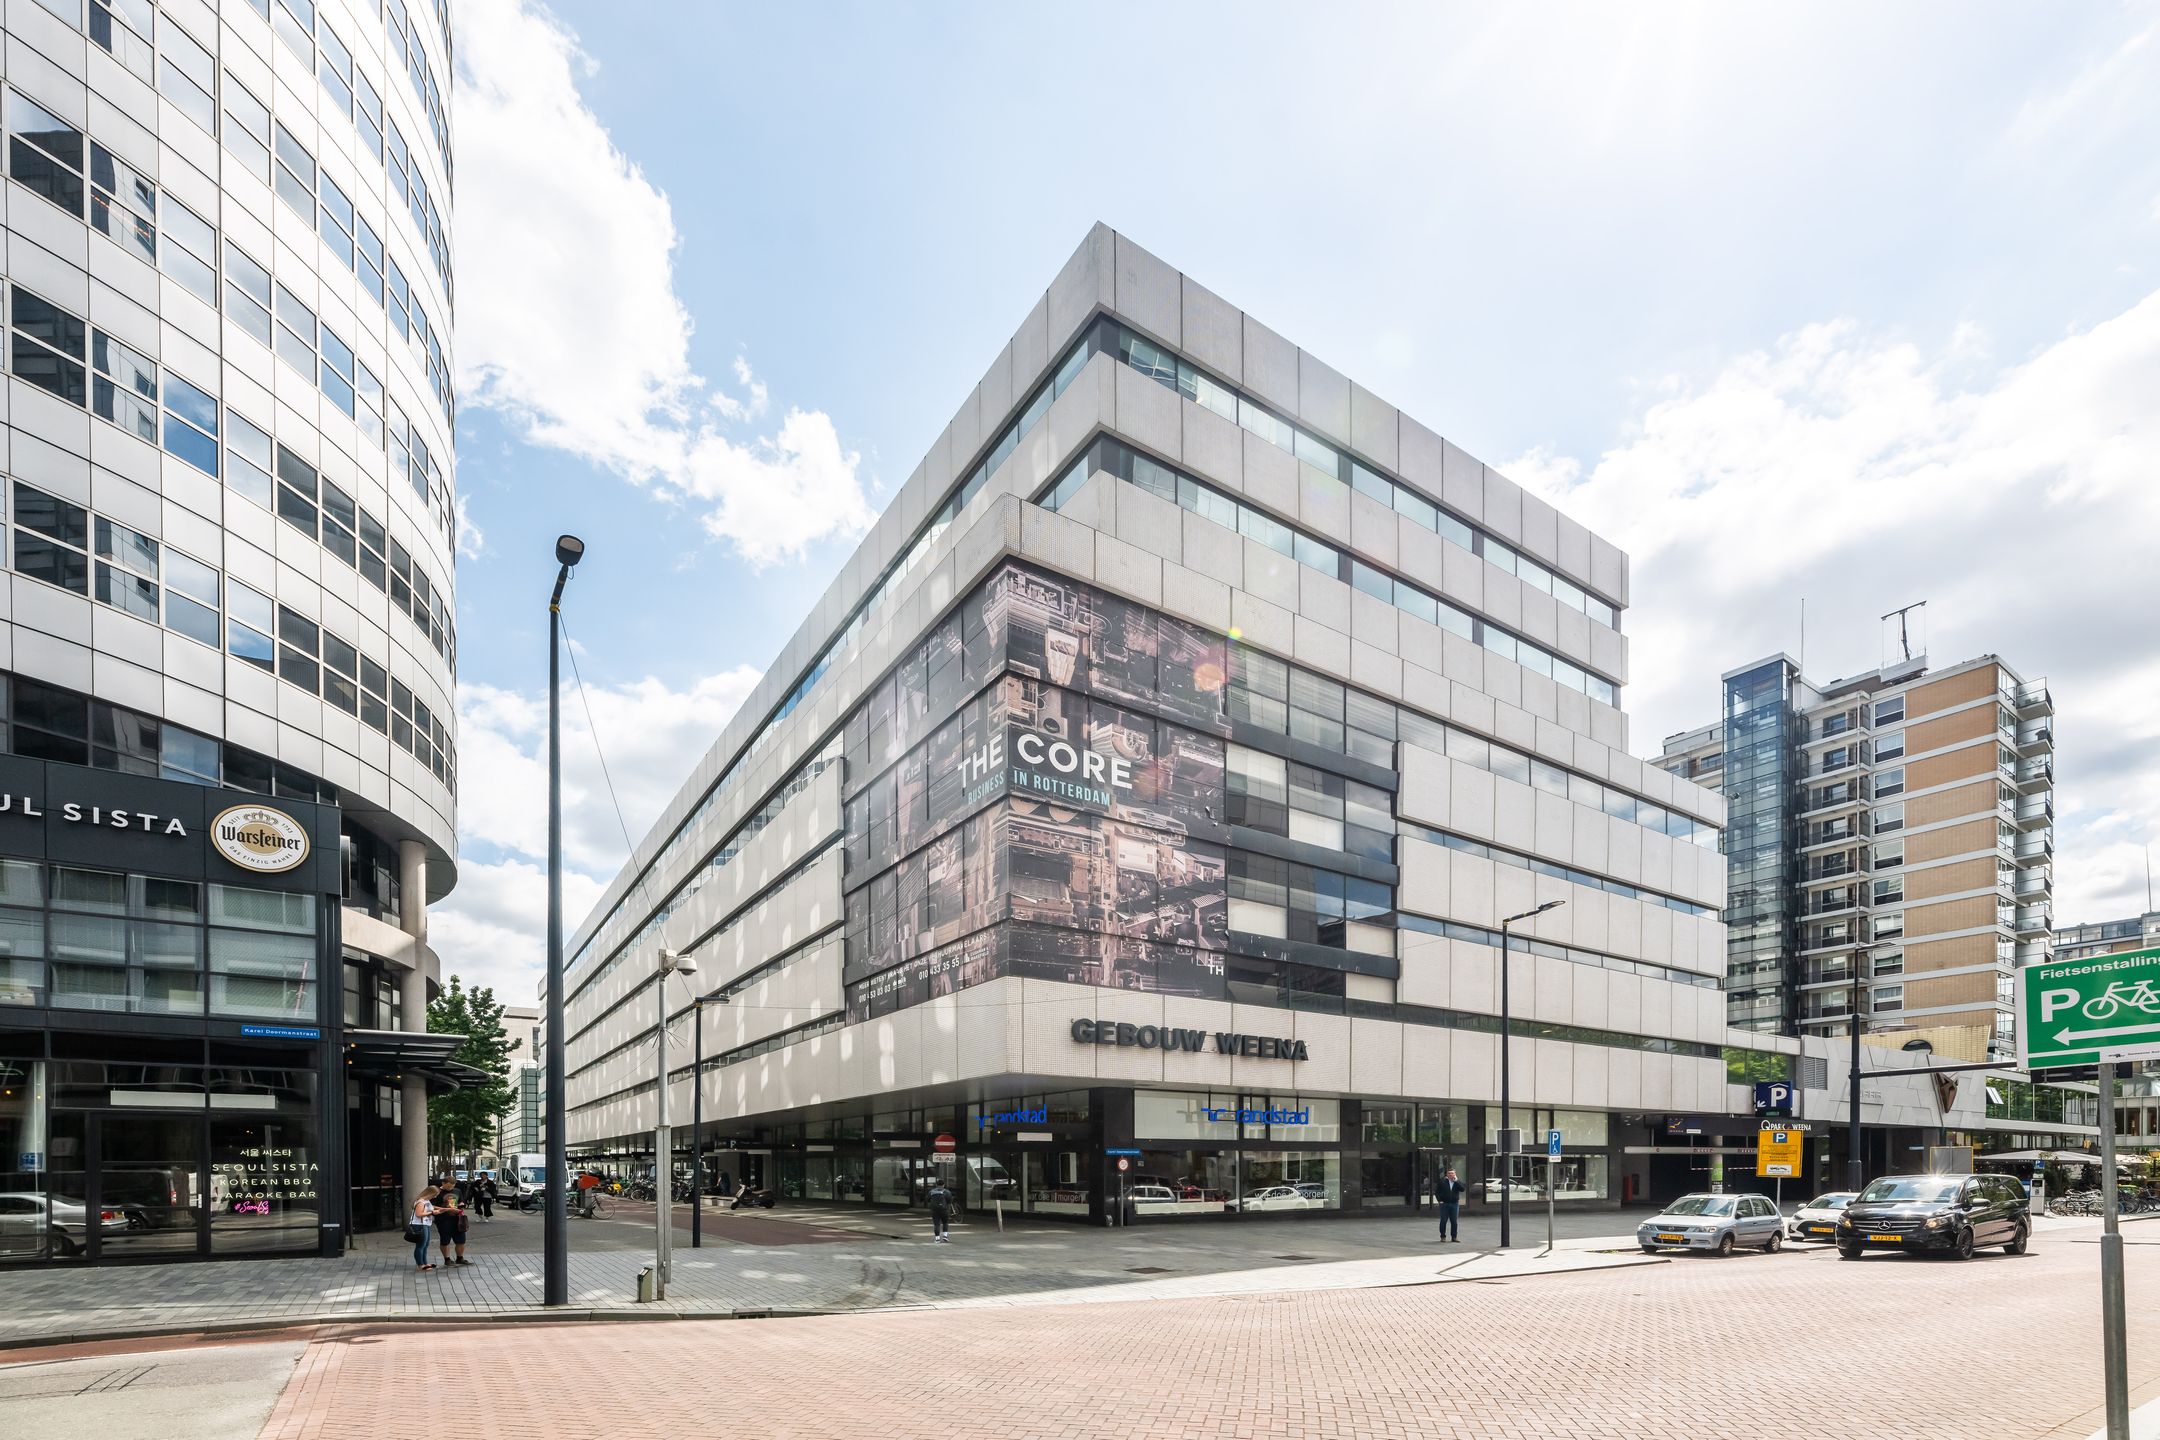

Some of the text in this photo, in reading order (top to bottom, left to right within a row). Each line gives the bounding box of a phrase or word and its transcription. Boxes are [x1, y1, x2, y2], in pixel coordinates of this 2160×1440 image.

[958, 733, 1133, 790] THE CORE
[967, 769, 1111, 806] BUSINESS IN ROTTERDAM
[63, 803, 187, 837] SISTA
[221, 824, 301, 851] Warsteiner
[918, 969, 929, 981] 010
[942, 960, 950, 971] 35
[951, 956, 960, 968] 55
[2041, 988, 2080, 1023] P
[265, 1029, 317, 1037] Doormanstraat
[1071, 1018, 1309, 1061] GEBOUW WEENA
[1770, 1087, 1787, 1107] P
[1236, 1105, 1309, 1125] randstad
[1552, 1132, 1559, 1145] P
[1776, 1133, 1786, 1143] P
[240, 1148, 259, 1157] 서울
[212, 1163, 319, 1172] SEOUL SISTA
[220, 1178, 312, 1186] KOREAN BBQ
[225, 1191, 283, 1199] ARAOKE
[1058, 1193, 1084, 1203] morgen
